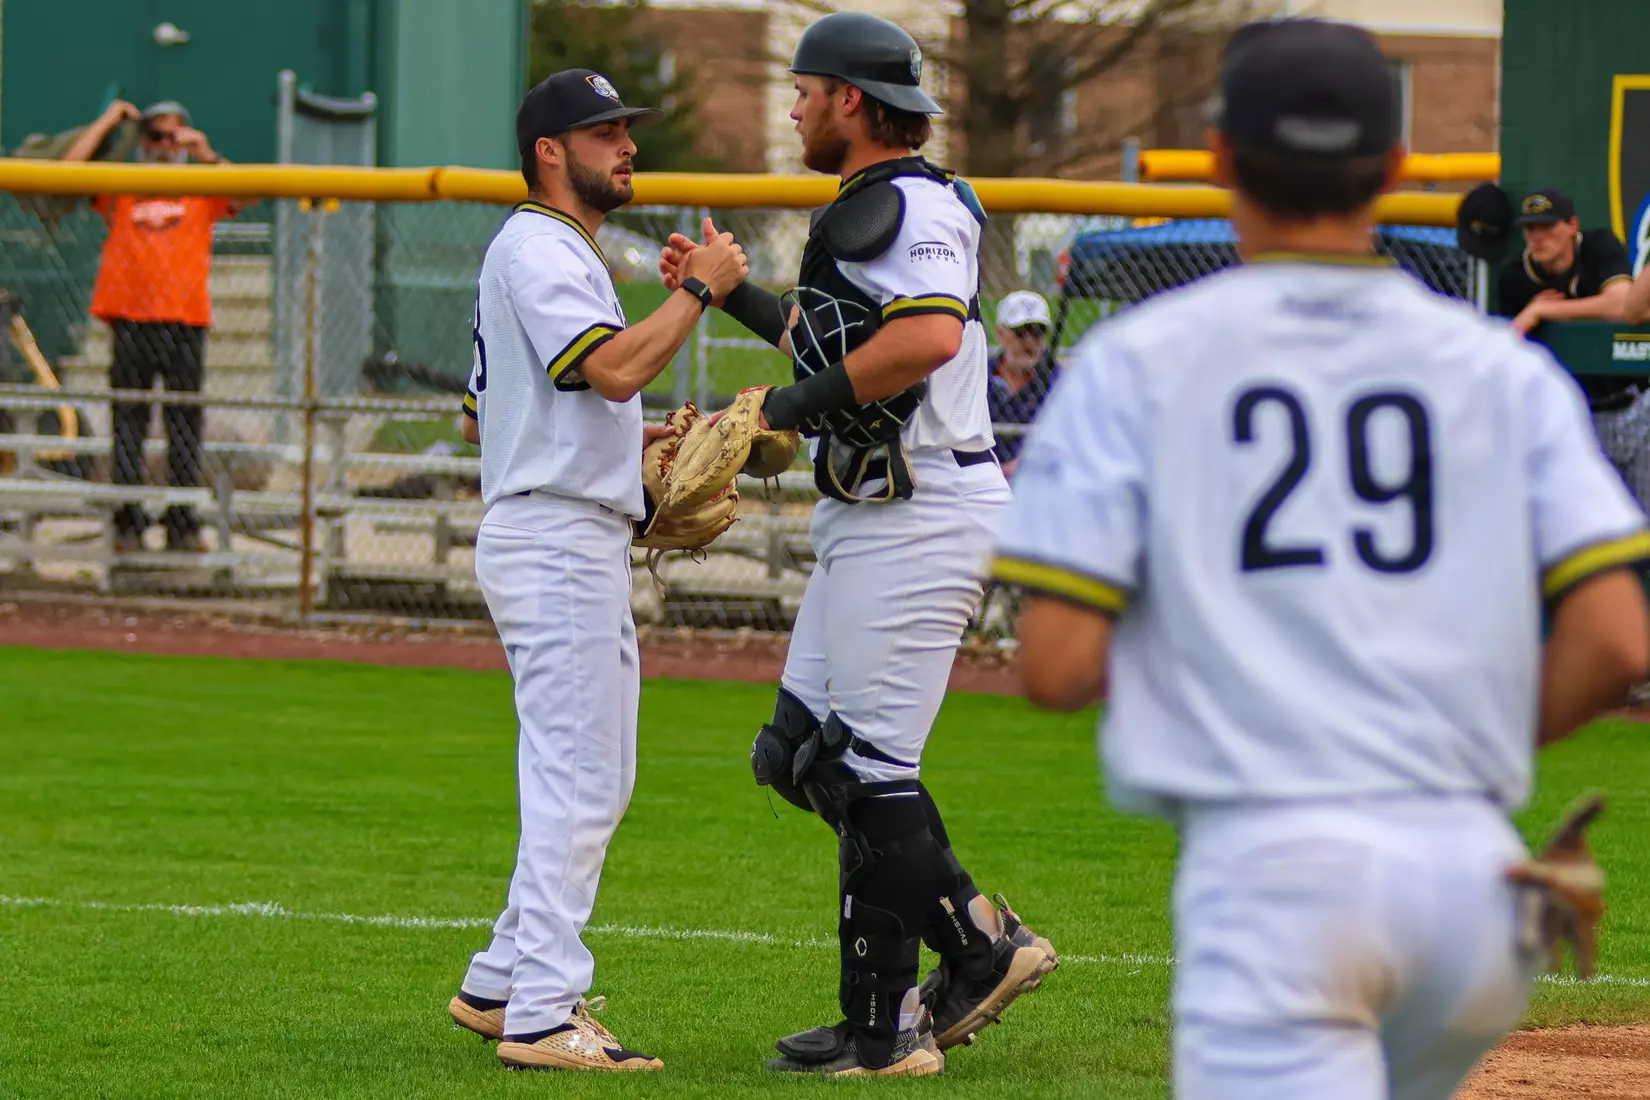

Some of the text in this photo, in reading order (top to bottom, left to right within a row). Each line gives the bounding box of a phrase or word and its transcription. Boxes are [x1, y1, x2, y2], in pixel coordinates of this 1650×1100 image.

[909, 247, 957, 258] HORIZON
[1611, 341, 1650, 361] MAS
[1233, 386, 1435, 573] 29
